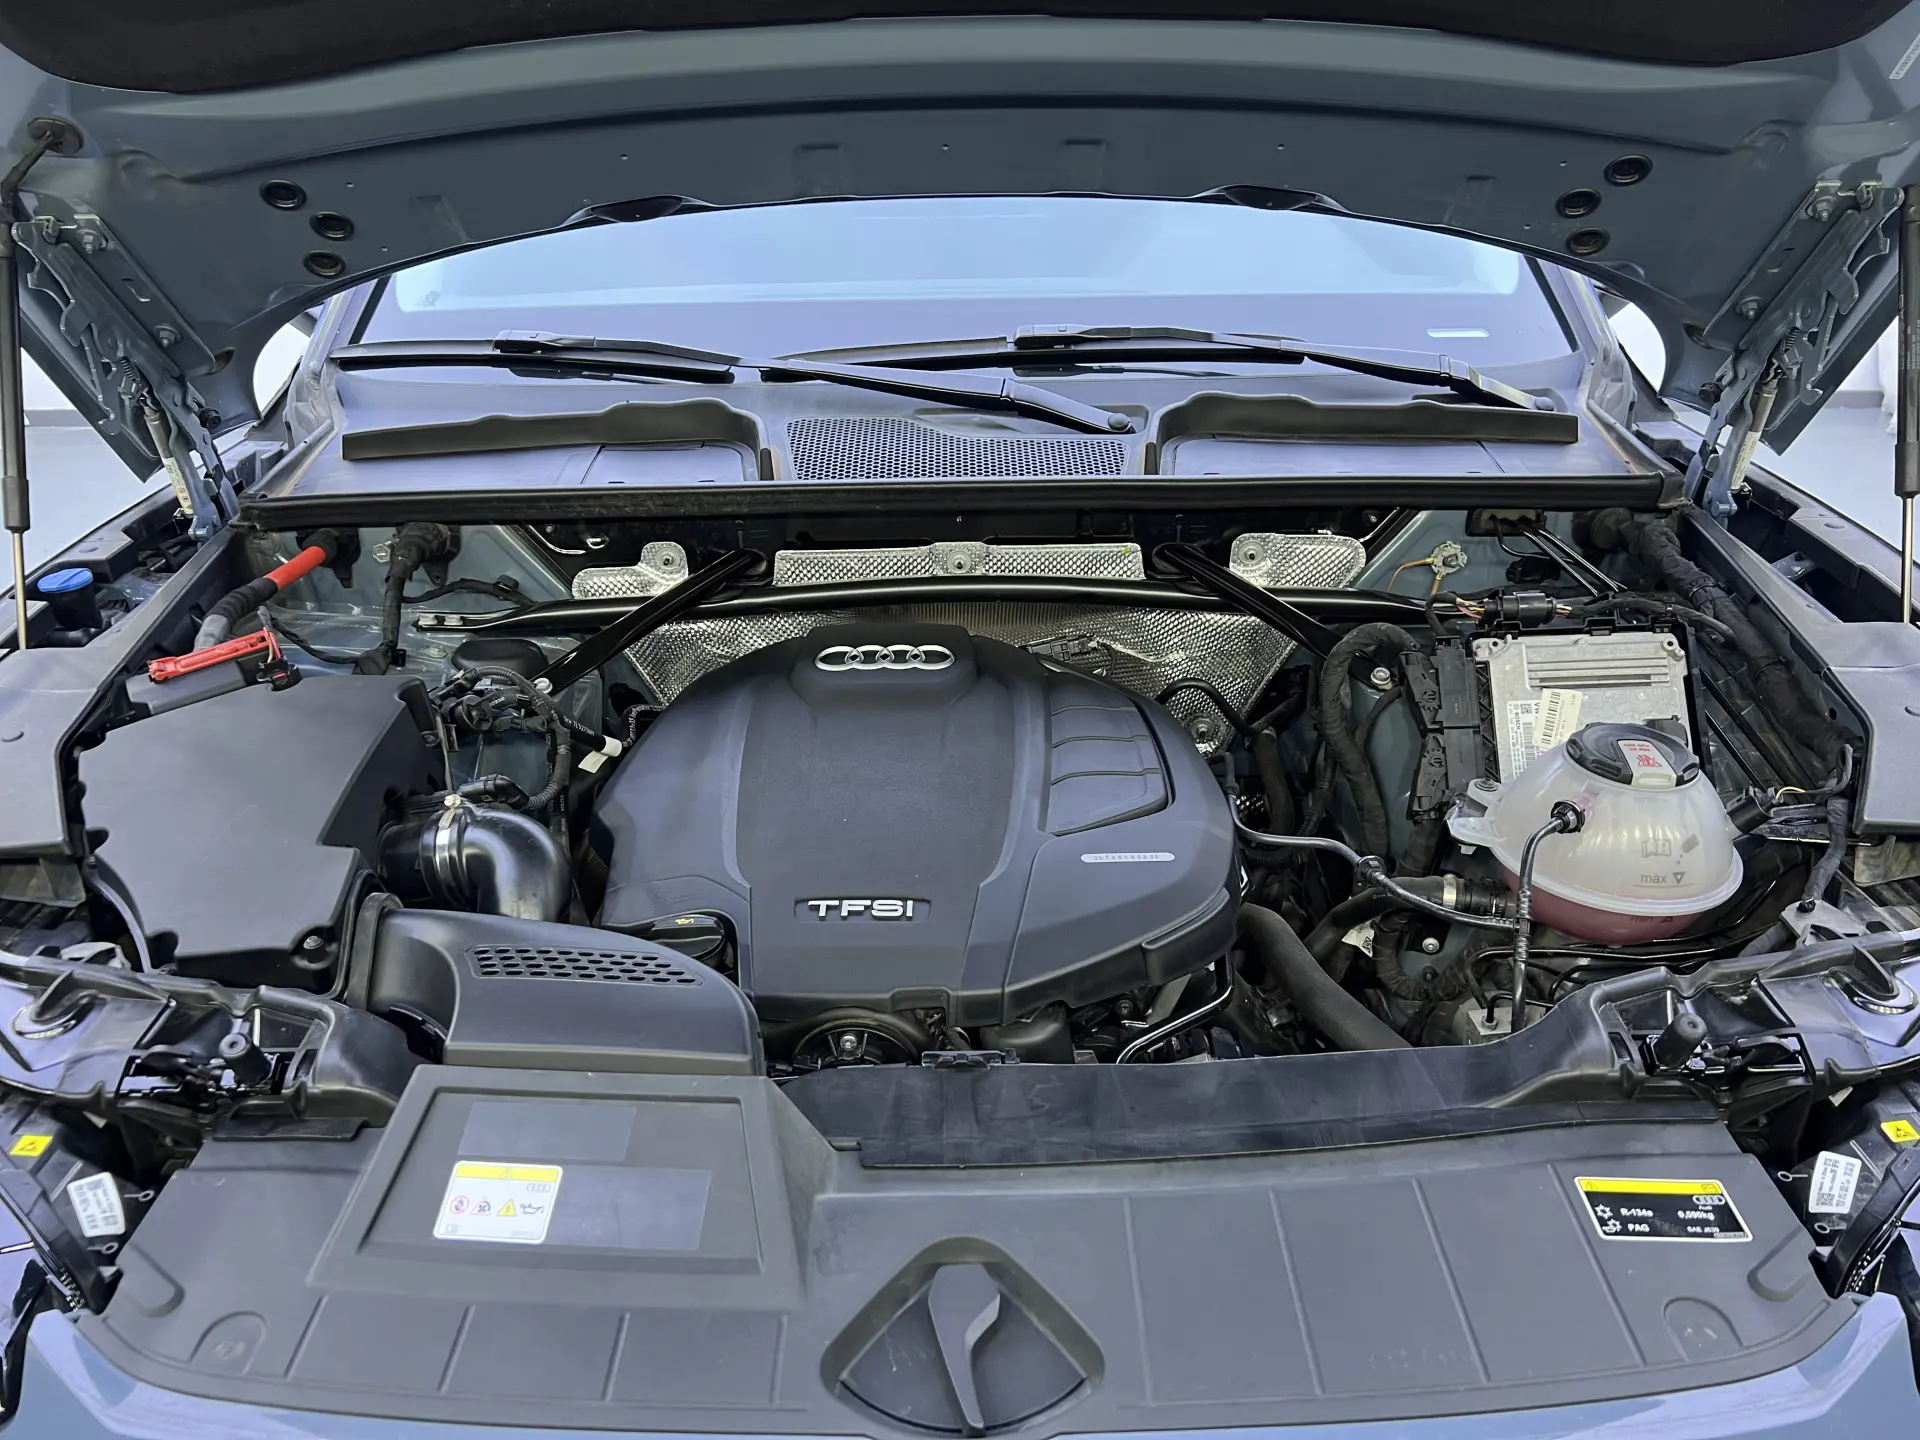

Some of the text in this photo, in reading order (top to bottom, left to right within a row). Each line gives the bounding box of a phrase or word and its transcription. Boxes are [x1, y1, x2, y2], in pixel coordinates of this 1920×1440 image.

[1513, 711, 1521, 731] BOSCH
[1640, 874, 1667, 884] max
[807, 899, 914, 920] TFSI
[1620, 1208, 1654, 1217] R-134a
[1627, 1223, 1650, 1232] PAG
